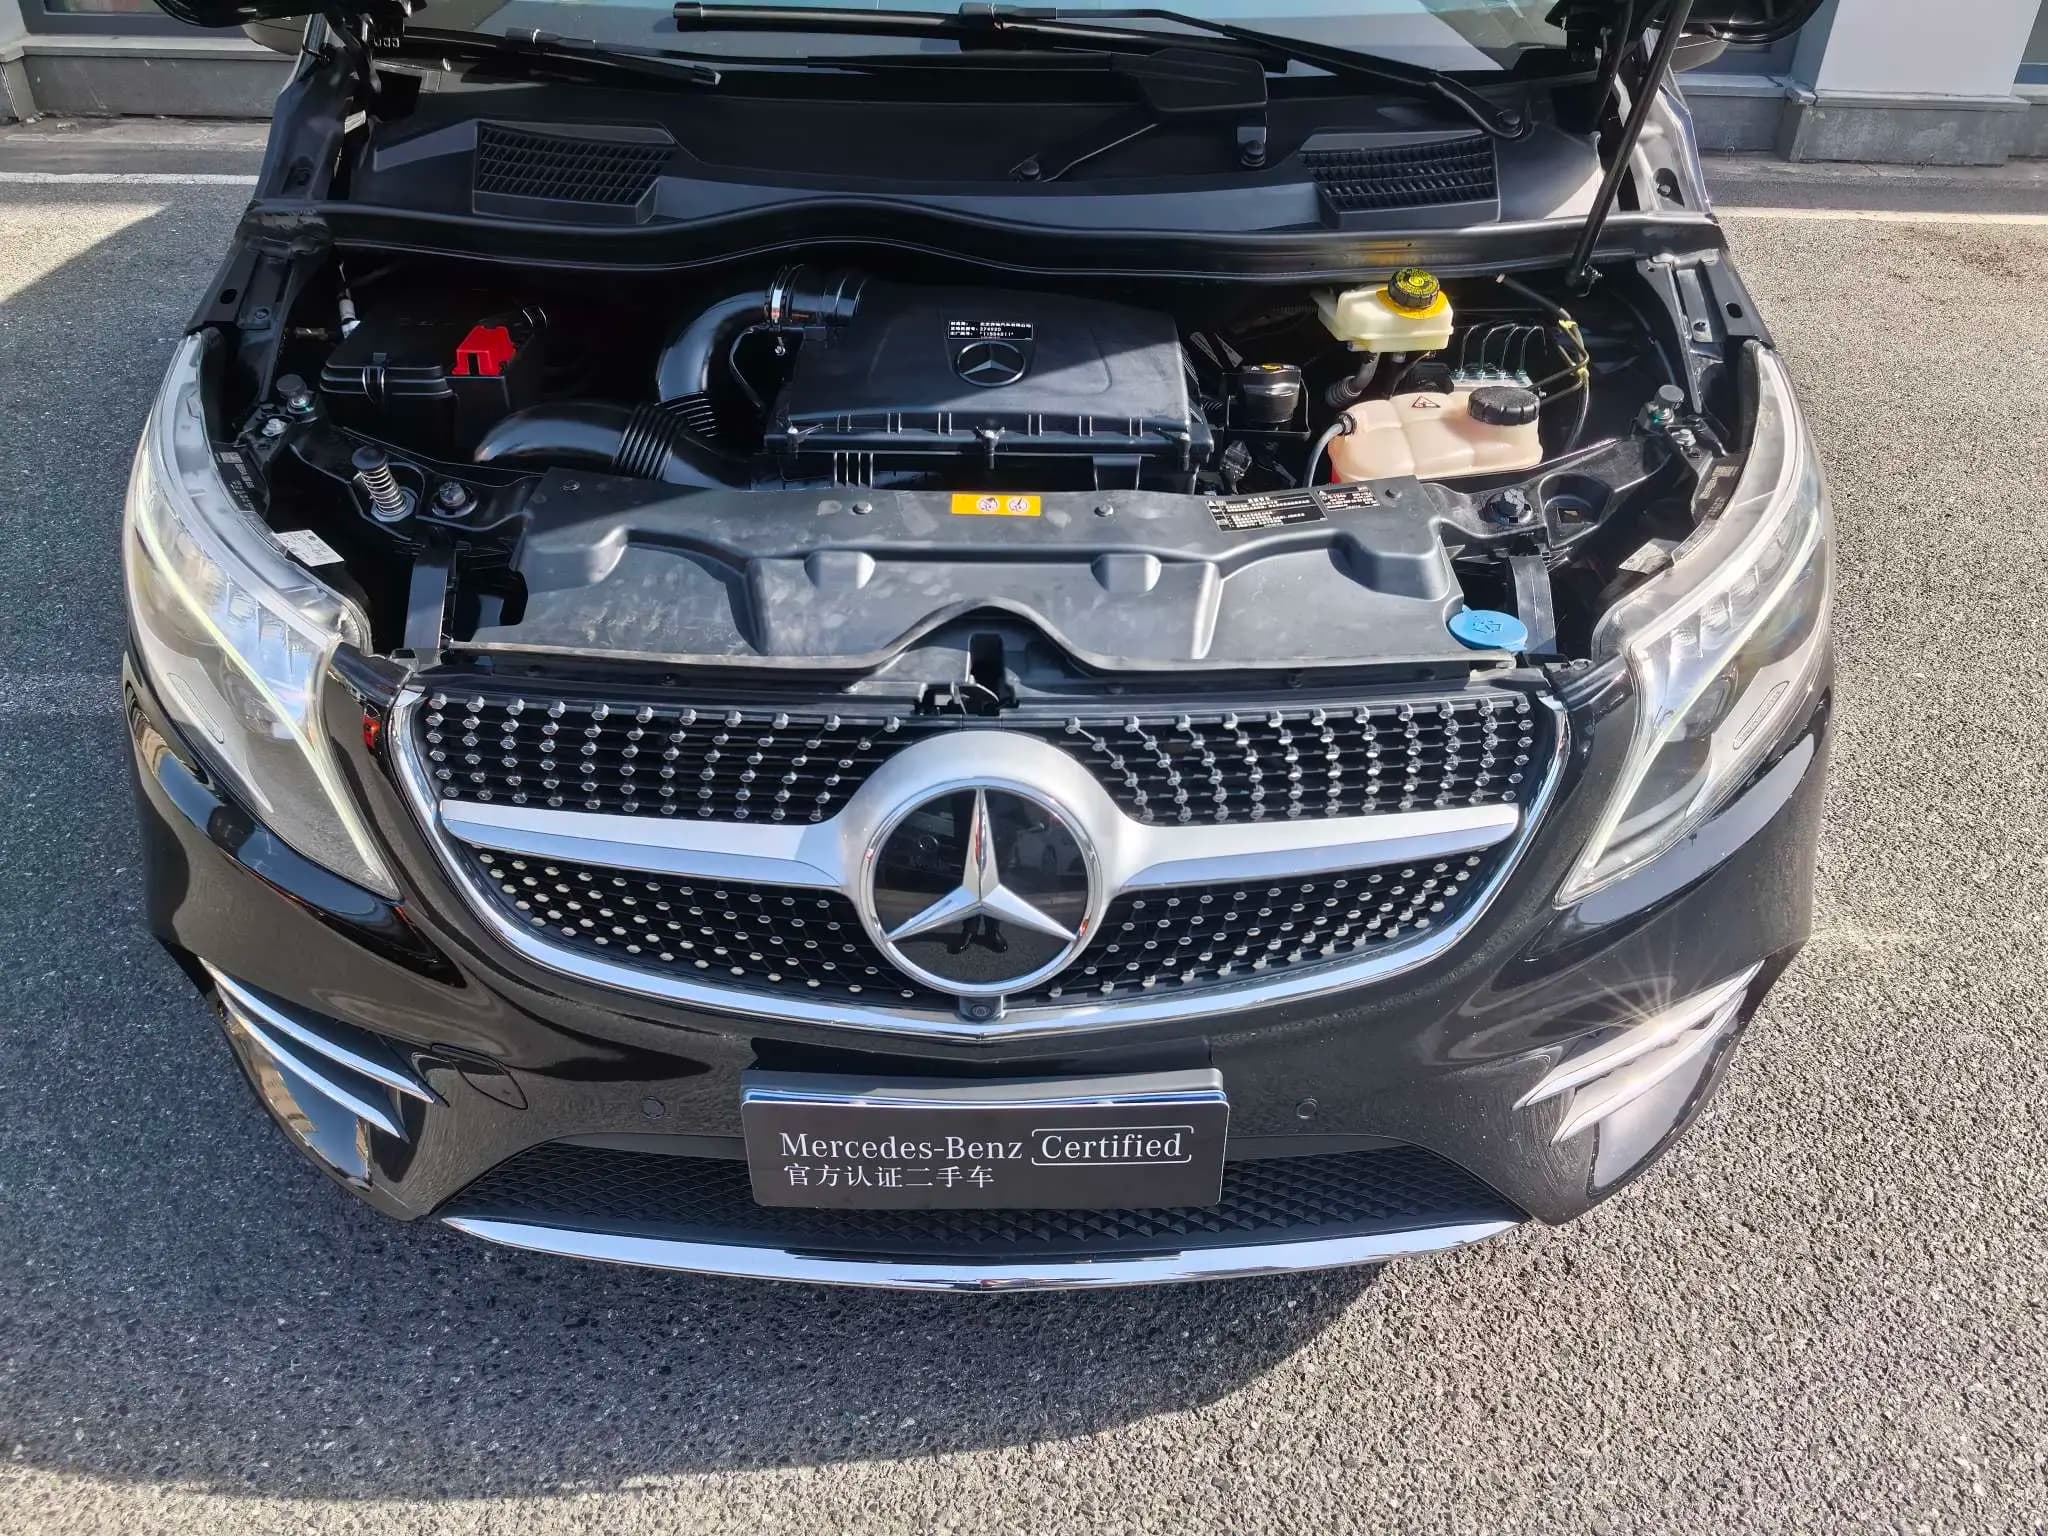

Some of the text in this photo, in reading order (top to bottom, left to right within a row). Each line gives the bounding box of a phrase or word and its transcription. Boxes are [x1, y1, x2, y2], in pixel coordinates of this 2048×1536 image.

[779, 1133, 1181, 1159] Mercedes-Benz Certified
[784, 1163, 994, 1188] 官方认证二手车
